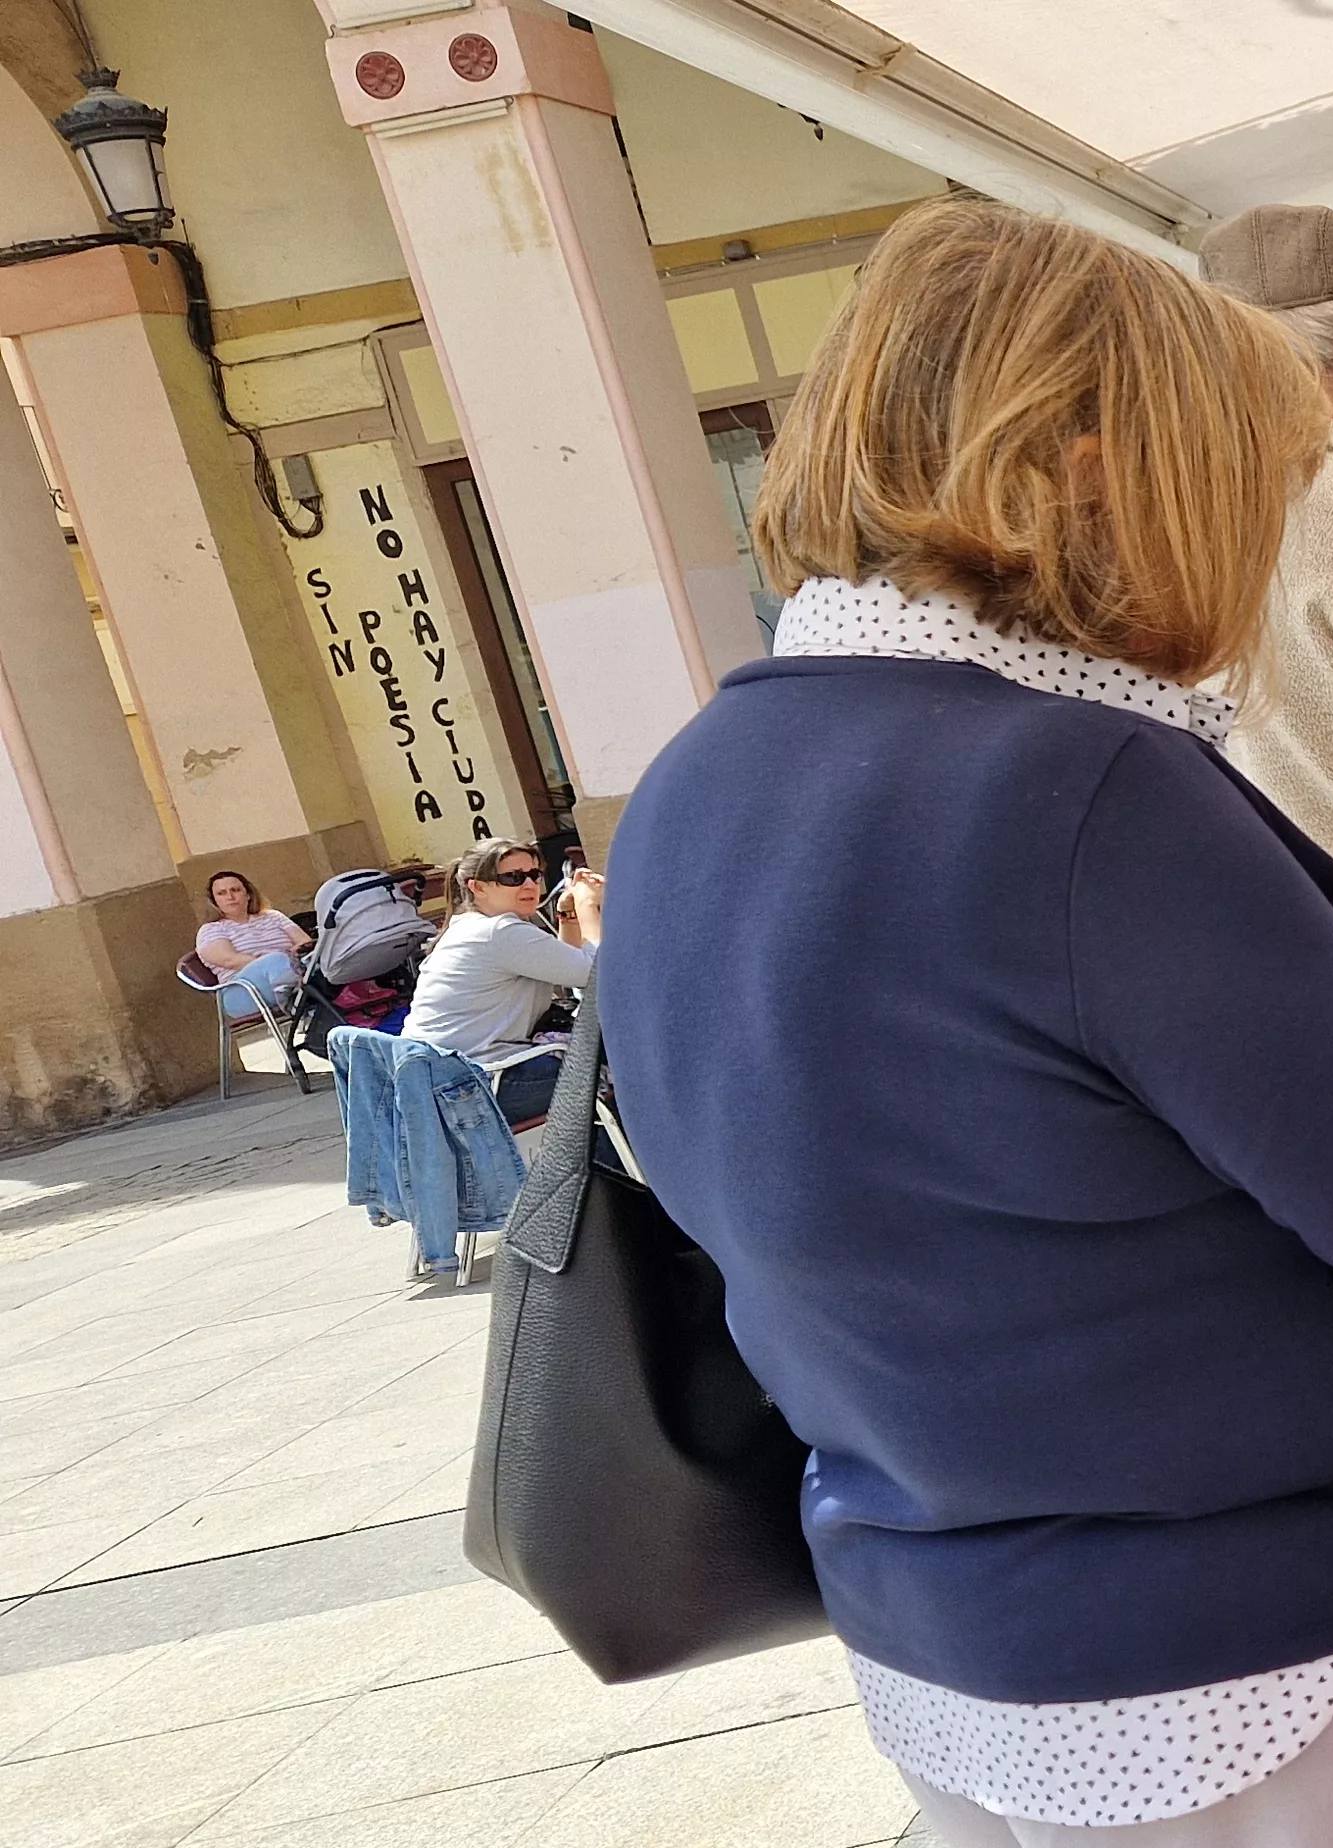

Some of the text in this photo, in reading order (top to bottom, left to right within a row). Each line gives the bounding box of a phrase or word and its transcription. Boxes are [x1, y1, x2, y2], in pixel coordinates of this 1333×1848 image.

[306, 568, 356, 678] SIN
[358, 609, 443, 824] POESIA
[359, 484, 493, 841] NO HAY CIUDA
